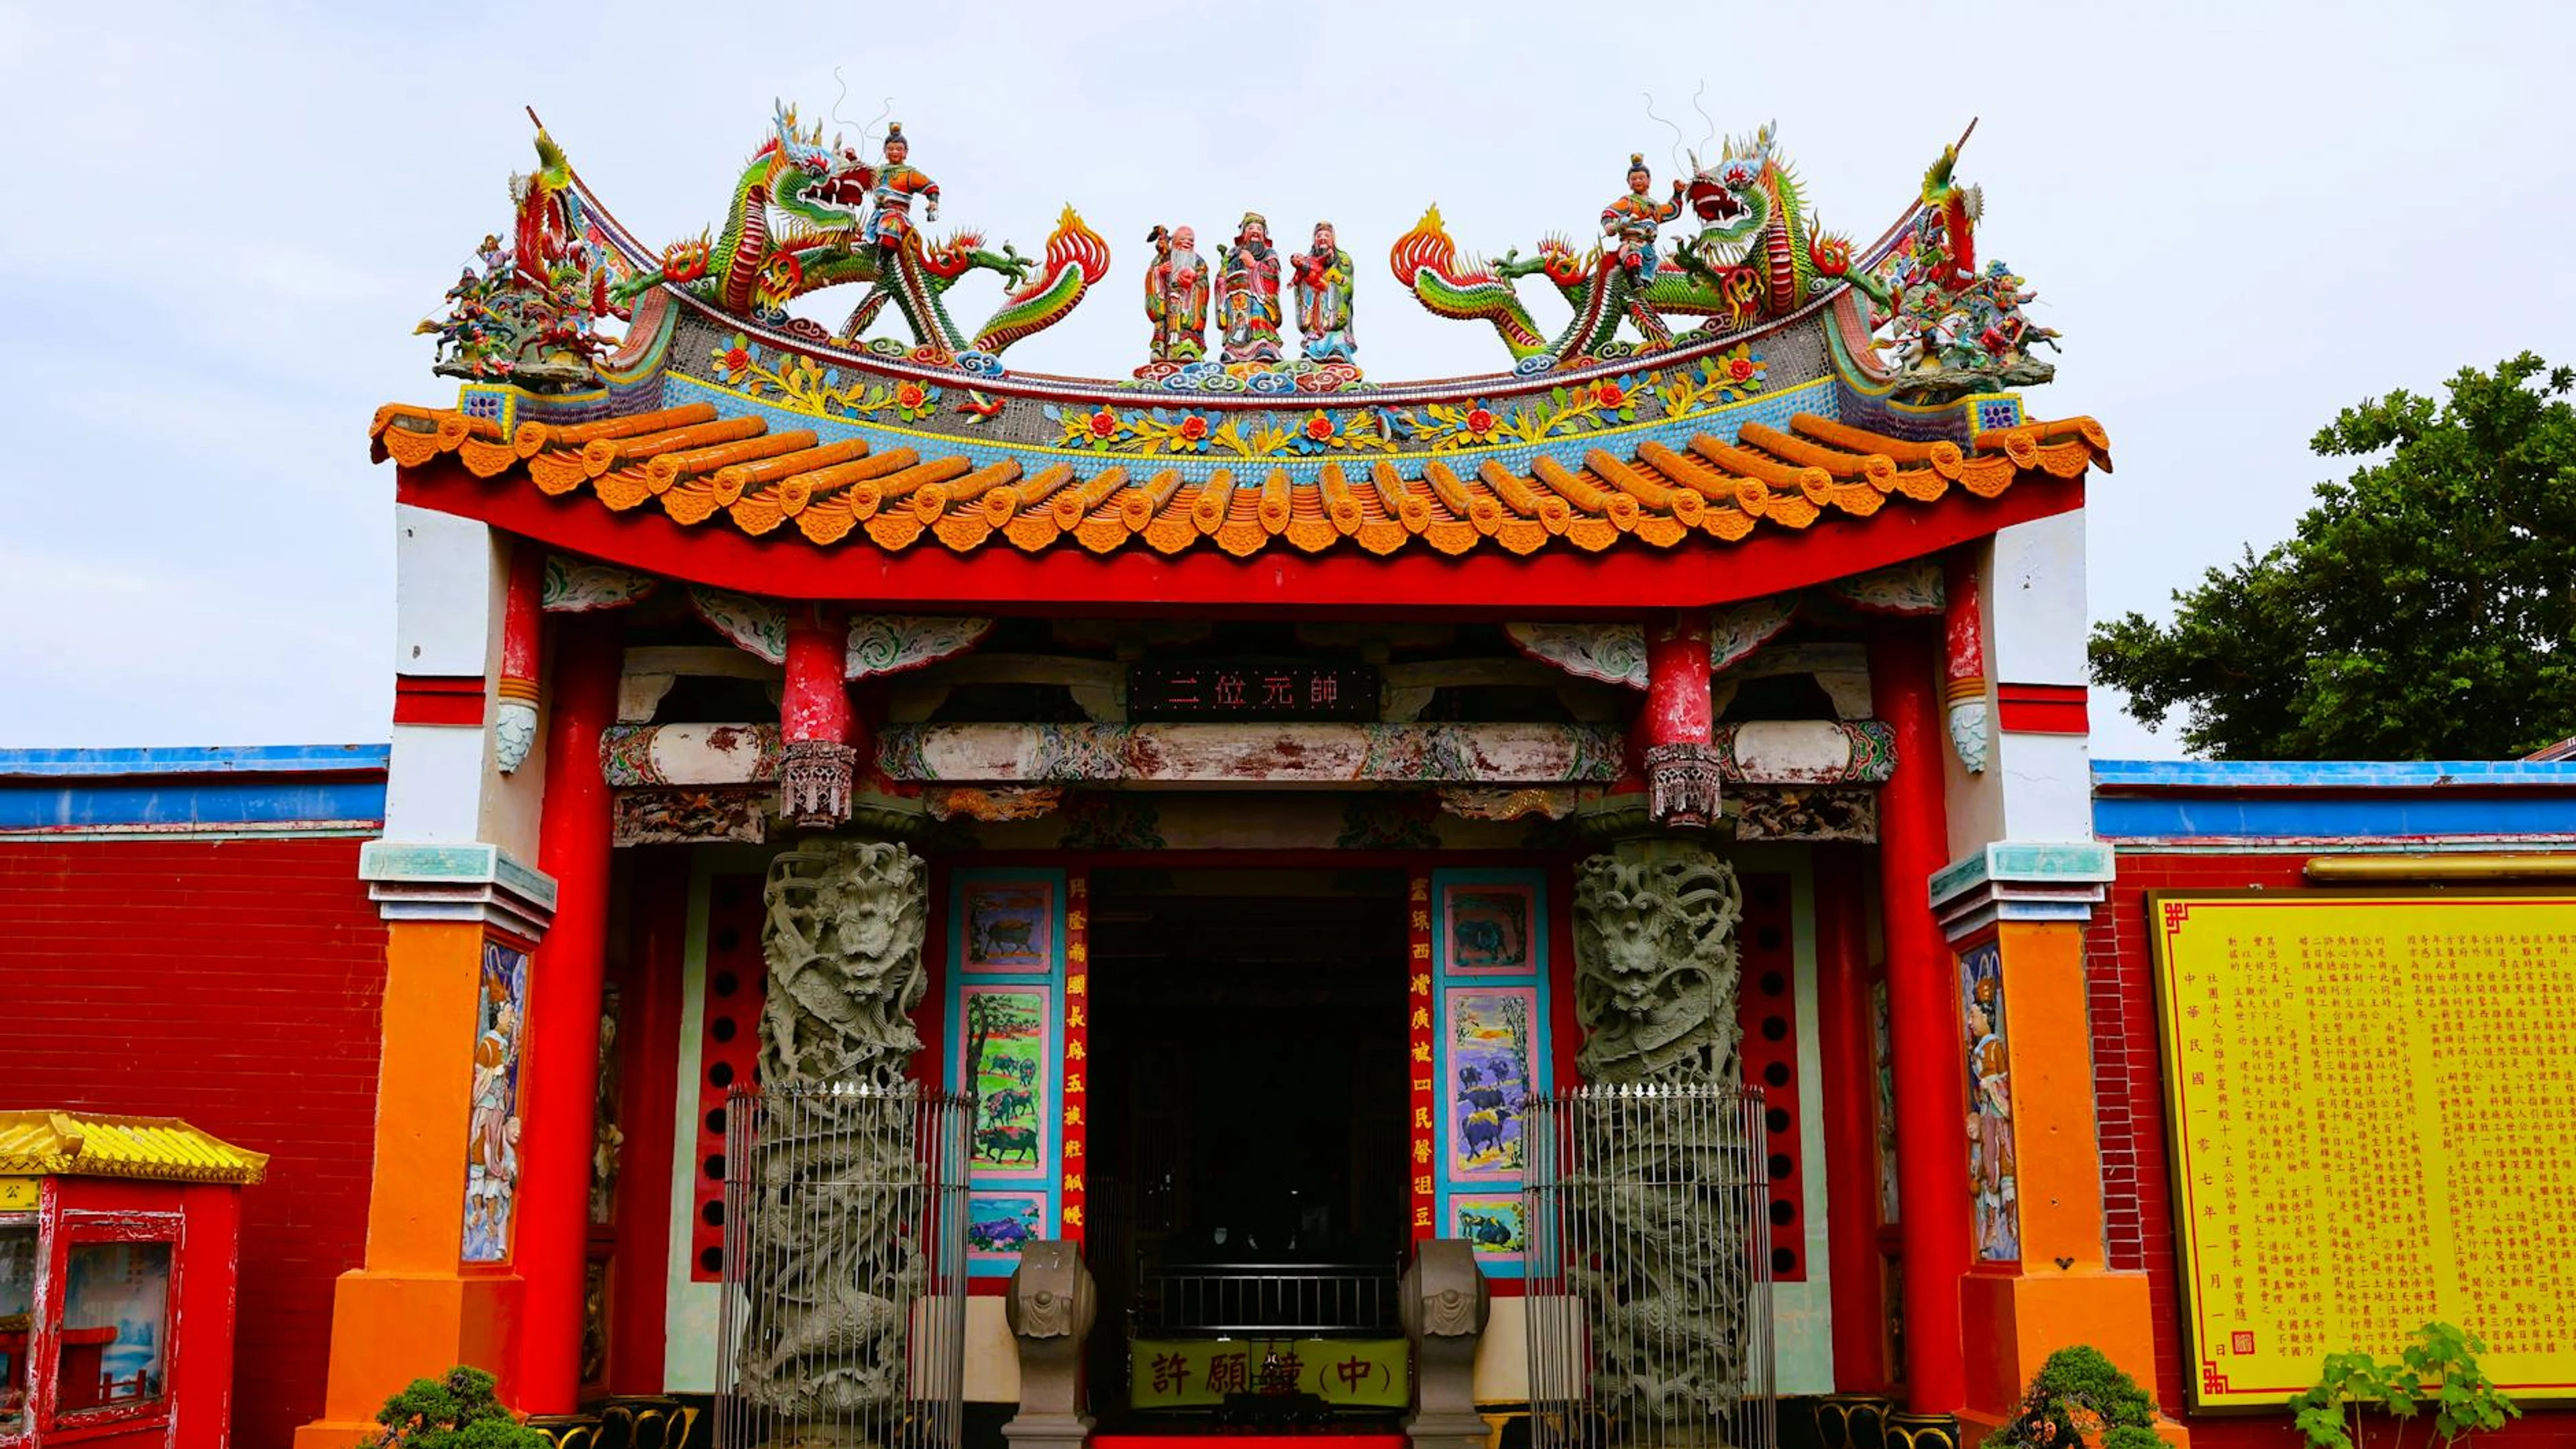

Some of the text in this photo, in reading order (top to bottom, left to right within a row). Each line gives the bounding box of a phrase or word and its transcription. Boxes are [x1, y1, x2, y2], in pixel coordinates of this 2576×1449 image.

[1165, 675, 1338, 705] 二位元帥
[2183, 972, 2226, 1356] 中華民國一零七年一月一日
[7, 1184, 20, 1199] 公
